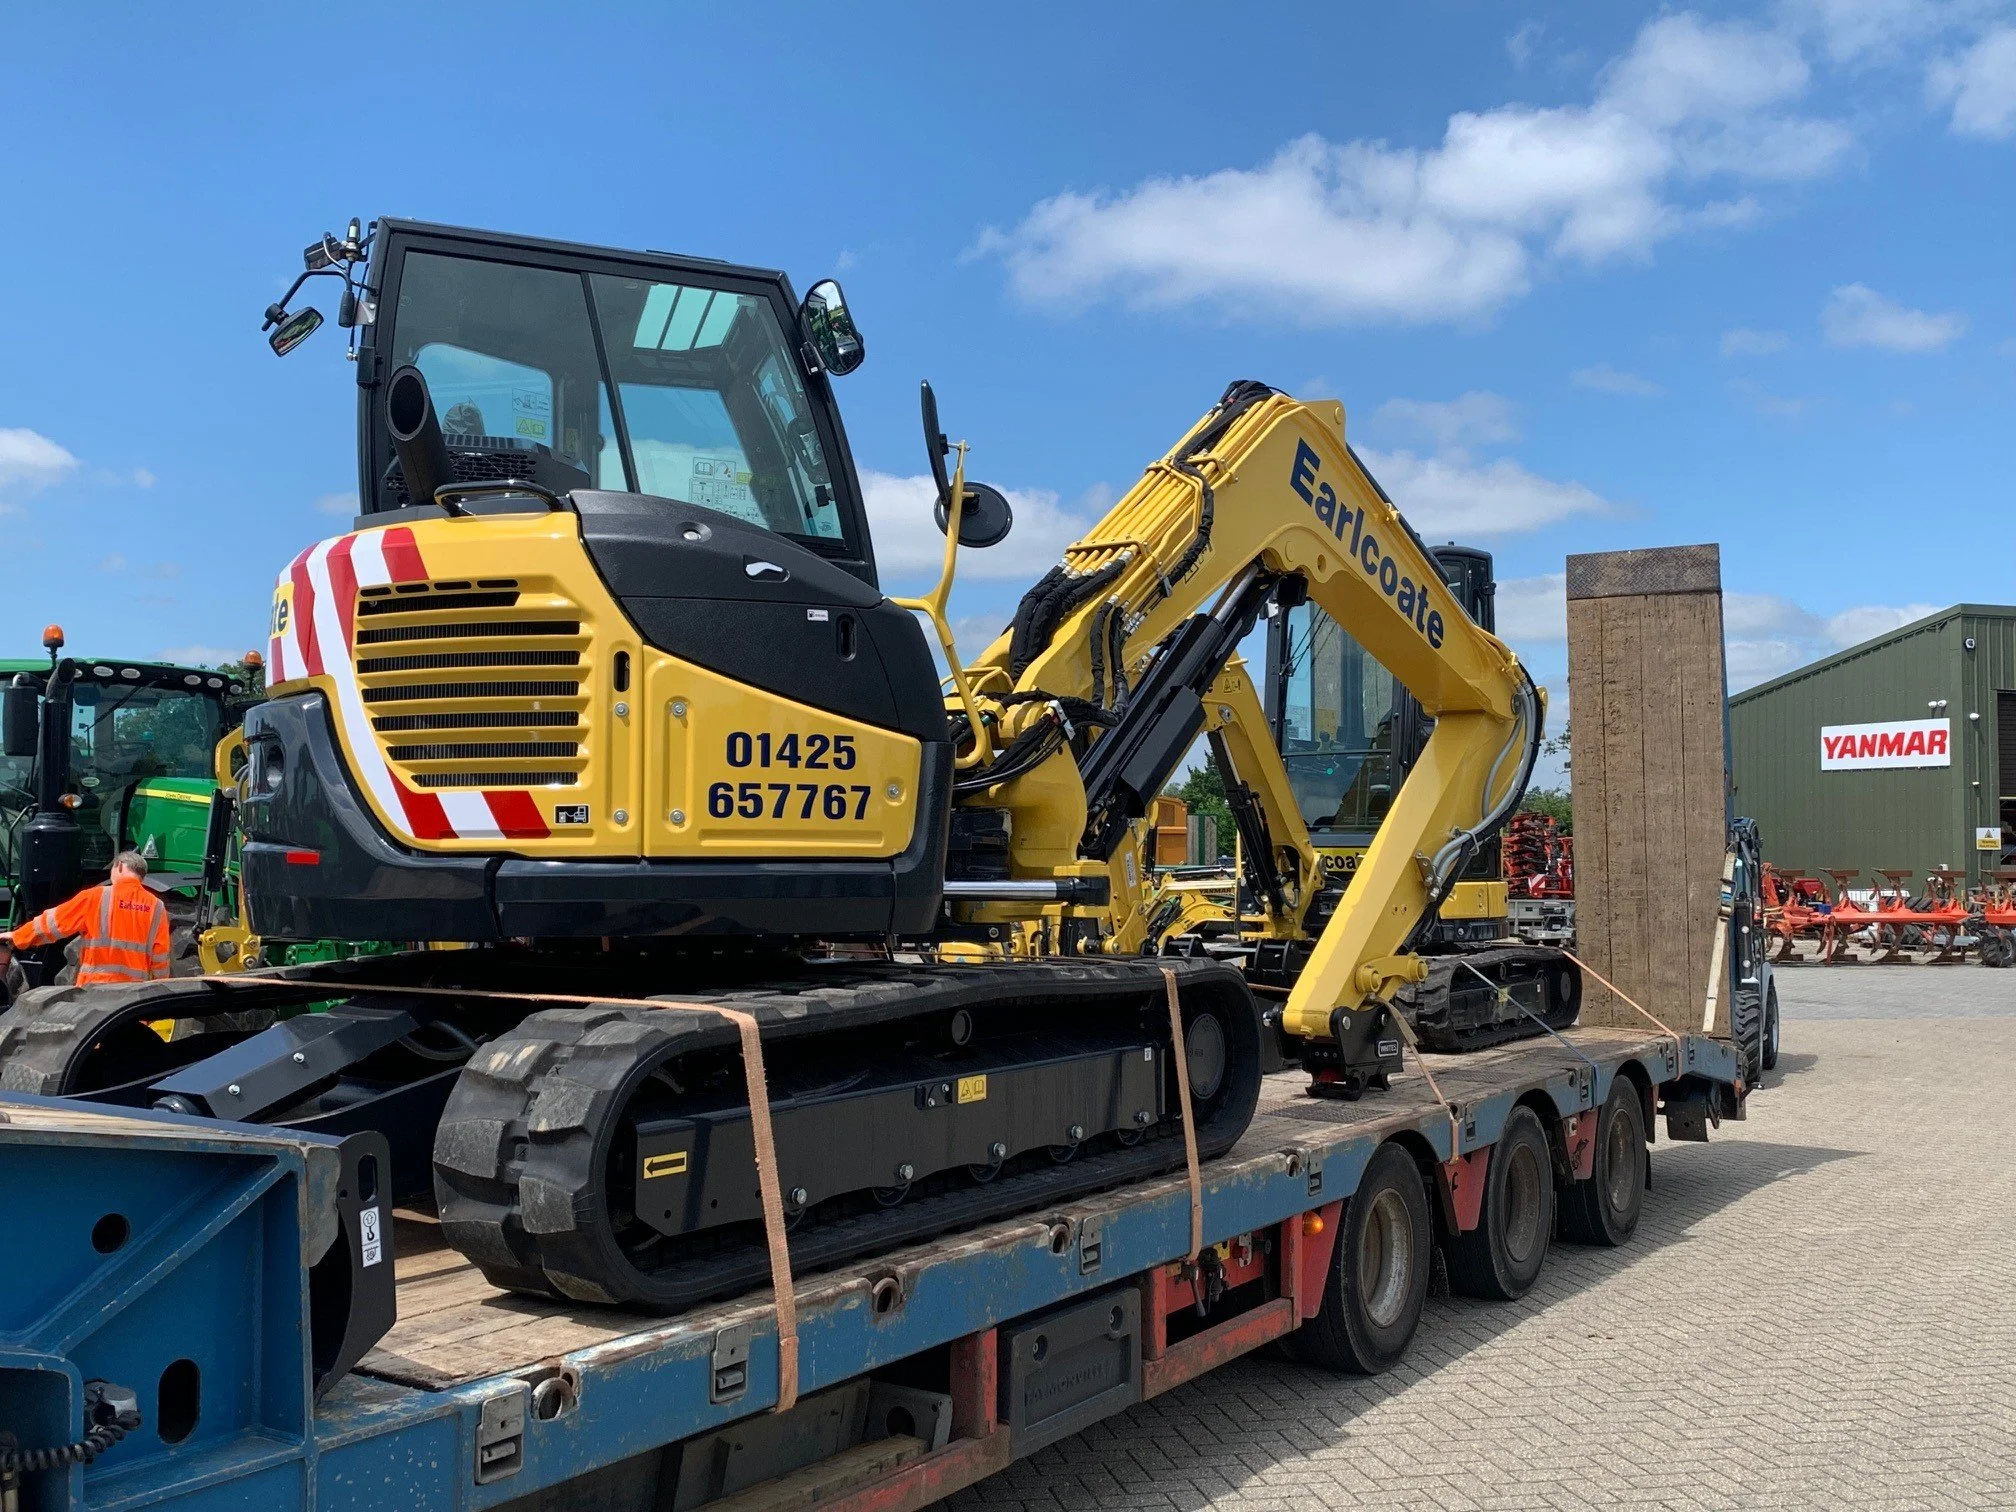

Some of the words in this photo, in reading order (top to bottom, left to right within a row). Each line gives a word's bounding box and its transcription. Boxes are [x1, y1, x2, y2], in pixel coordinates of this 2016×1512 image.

[1290, 437, 1444, 649] Earlcoate
[726, 731, 856, 770] 01425
[1823, 729, 1948, 759] YANMAR
[708, 782, 871, 820] 657767
